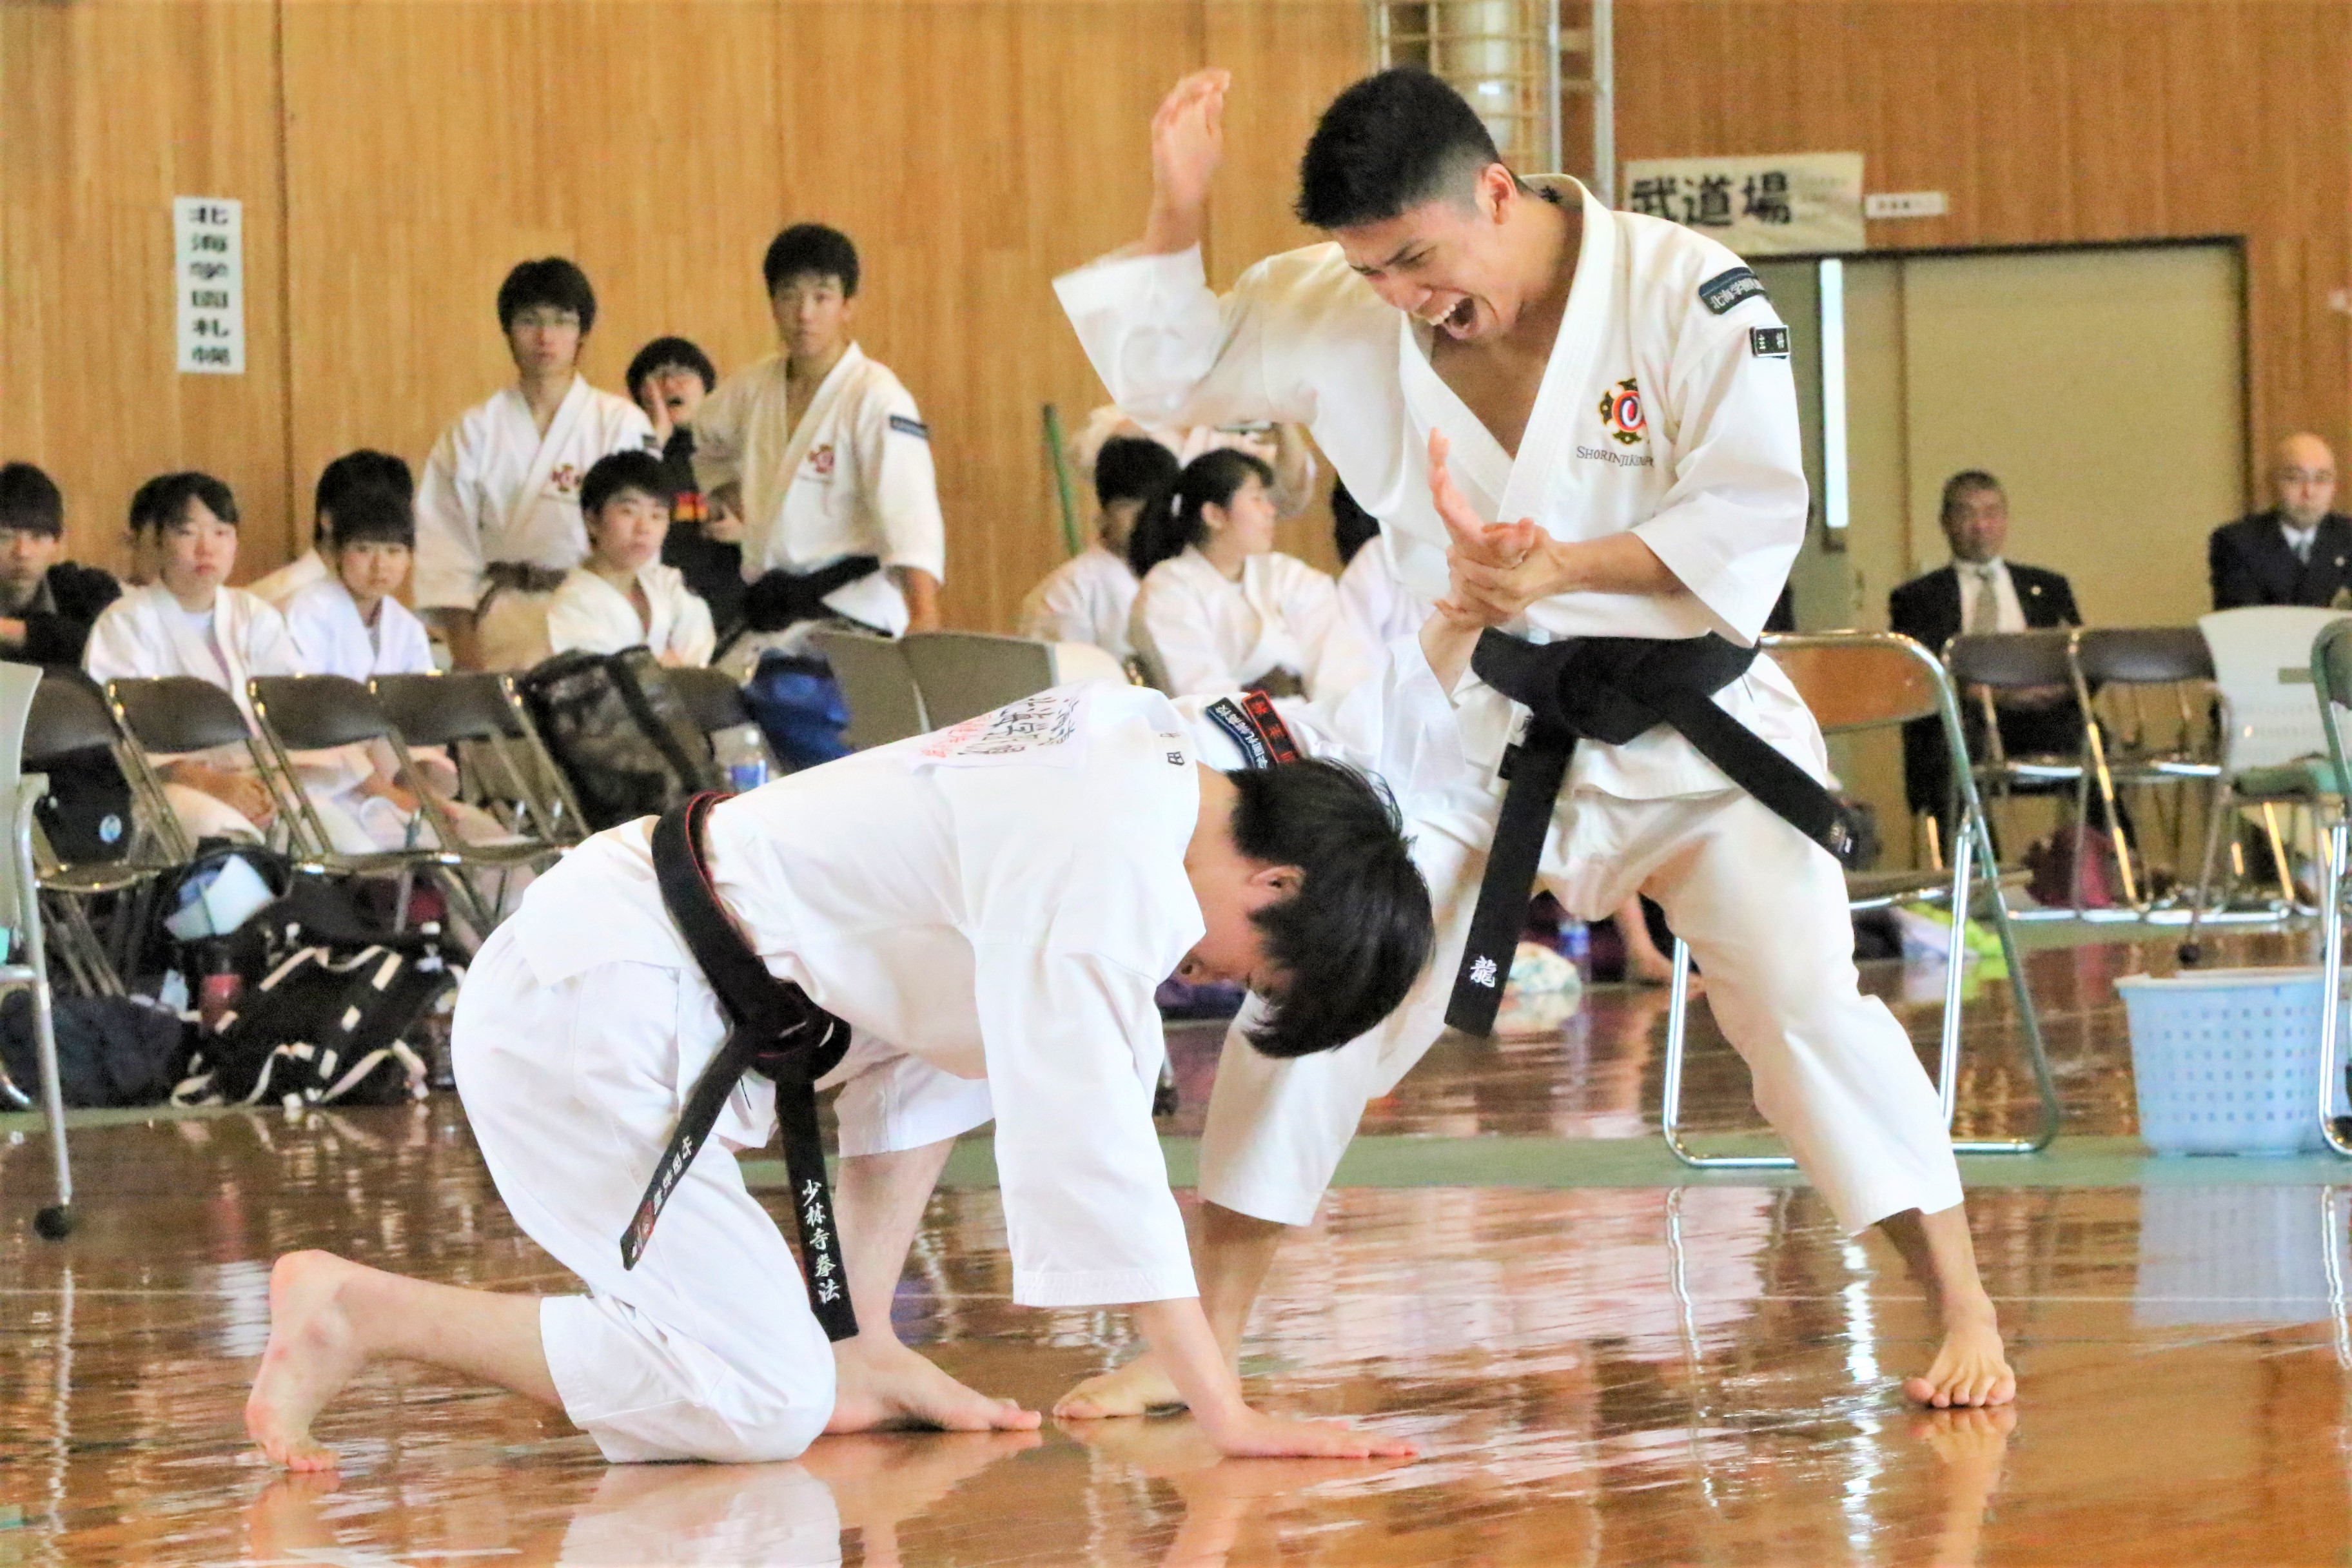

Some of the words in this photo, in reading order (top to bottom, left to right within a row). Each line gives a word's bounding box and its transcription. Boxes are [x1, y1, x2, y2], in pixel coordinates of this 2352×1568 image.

[1631, 170, 1793, 228] 武道場
[1470, 955, 1497, 988] 龍
[801, 1178, 841, 1305] 少林寺拳法
